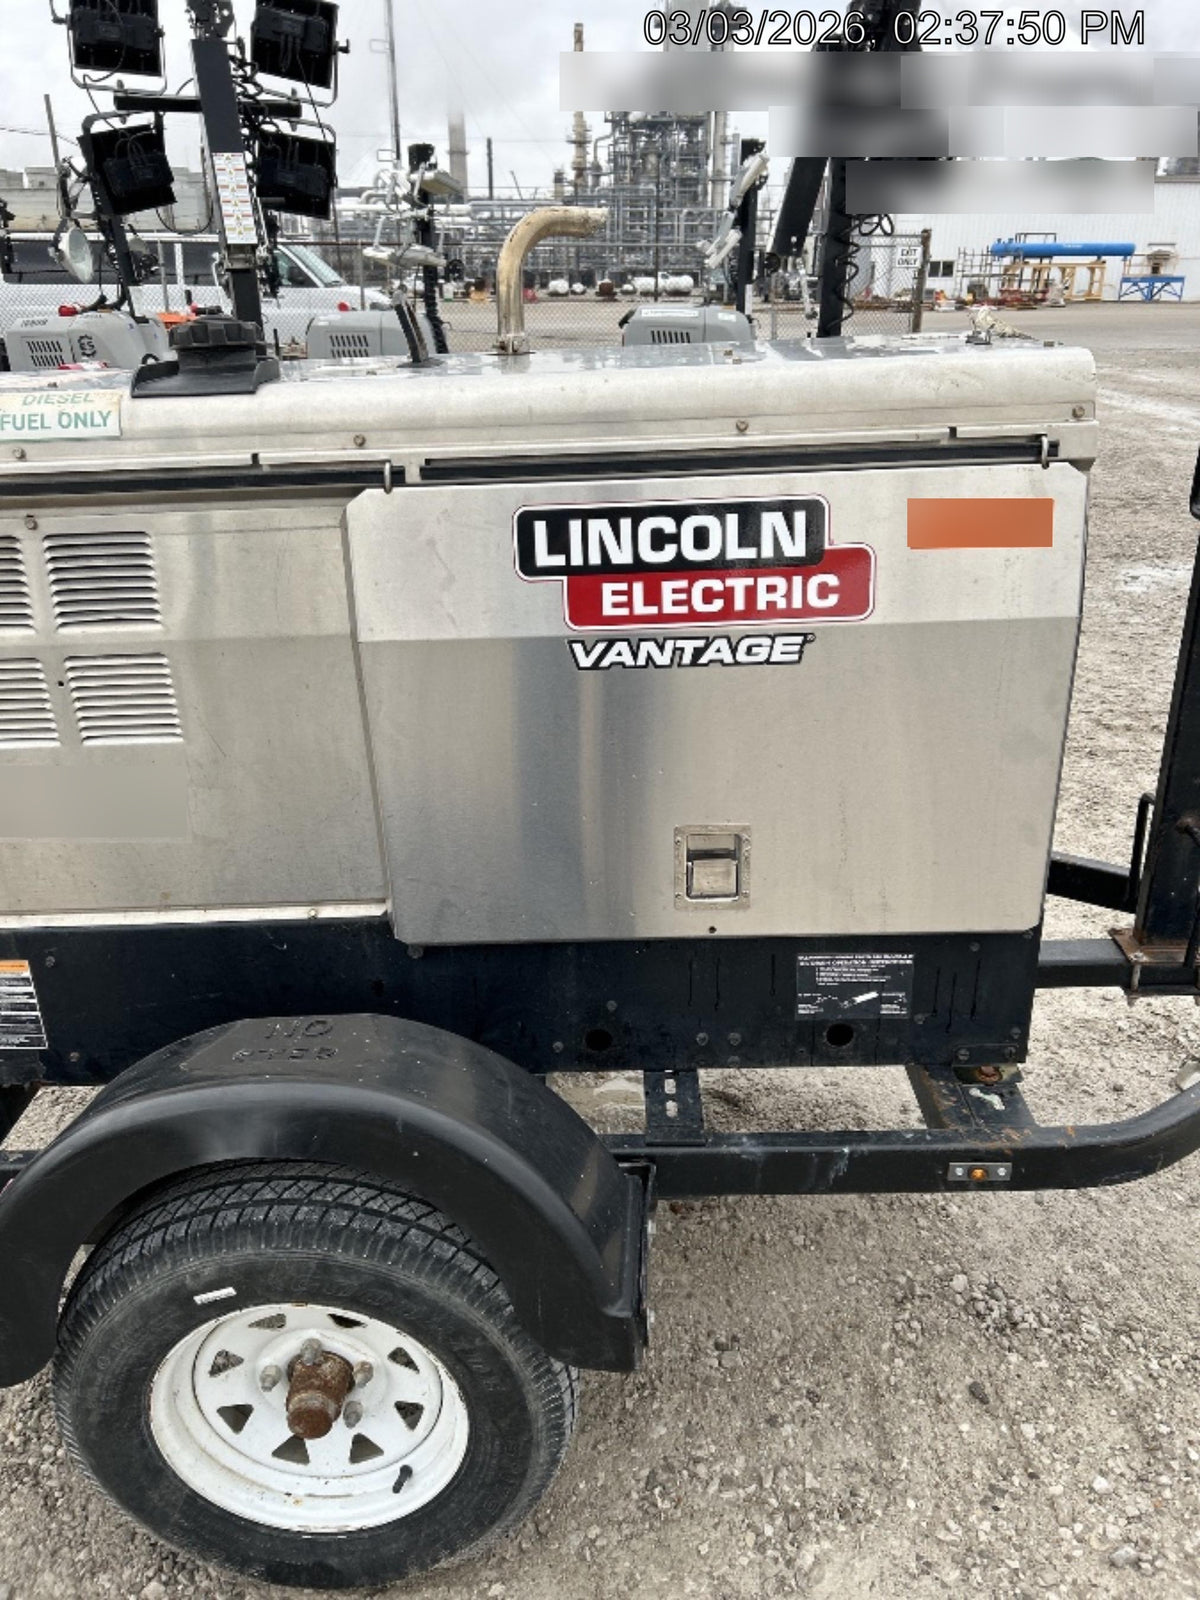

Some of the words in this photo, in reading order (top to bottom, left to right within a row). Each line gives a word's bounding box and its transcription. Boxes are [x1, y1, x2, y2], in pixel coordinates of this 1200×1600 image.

[897, 257, 918, 266] ONLY
[22, 392, 95, 407] DIESEL
[0, 413, 51, 431] FUEL
[57, 410, 112, 430] ONLY
[533, 510, 807, 568] LINCOLN
[601, 573, 841, 616] ELECTRIC
[569, 634, 804, 668] VANTAGE
